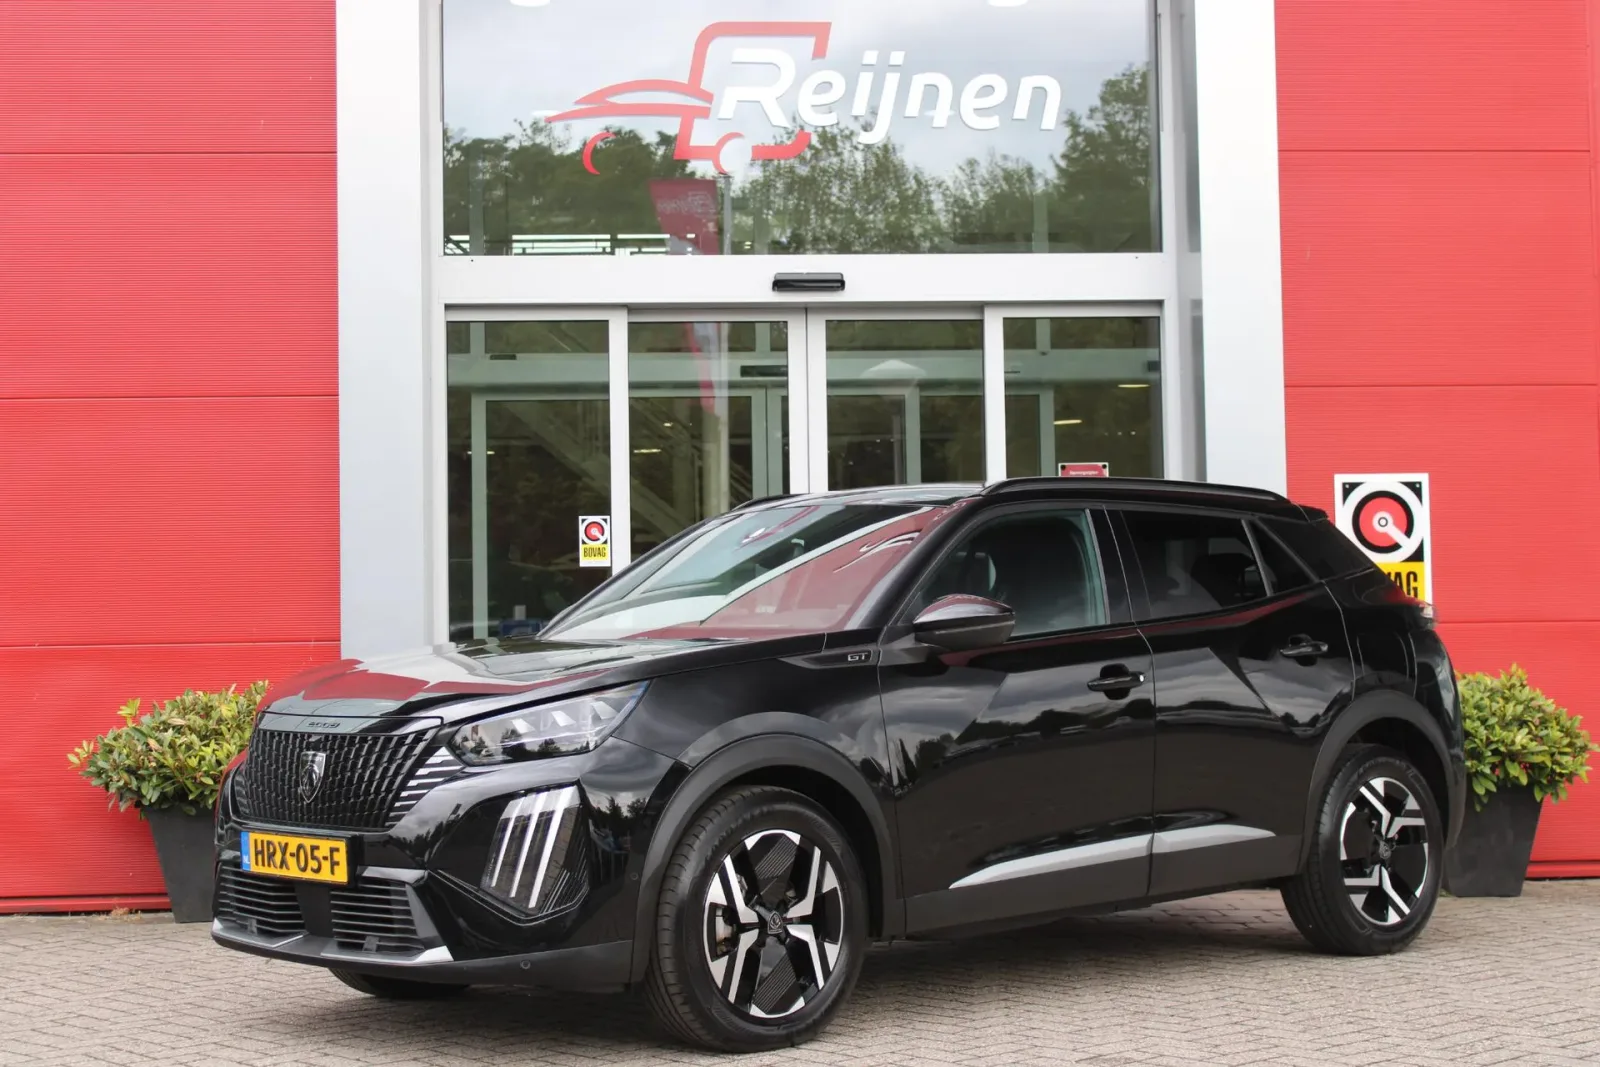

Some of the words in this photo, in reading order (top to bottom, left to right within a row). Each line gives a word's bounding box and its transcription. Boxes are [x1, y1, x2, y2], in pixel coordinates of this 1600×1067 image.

[718, 47, 1062, 144] Reijnen
[583, 547, 606, 558] BOVAG
[1387, 571, 1418, 599] AG
[847, 652, 868, 661] GT
[254, 838, 341, 876] HRX-05-F
